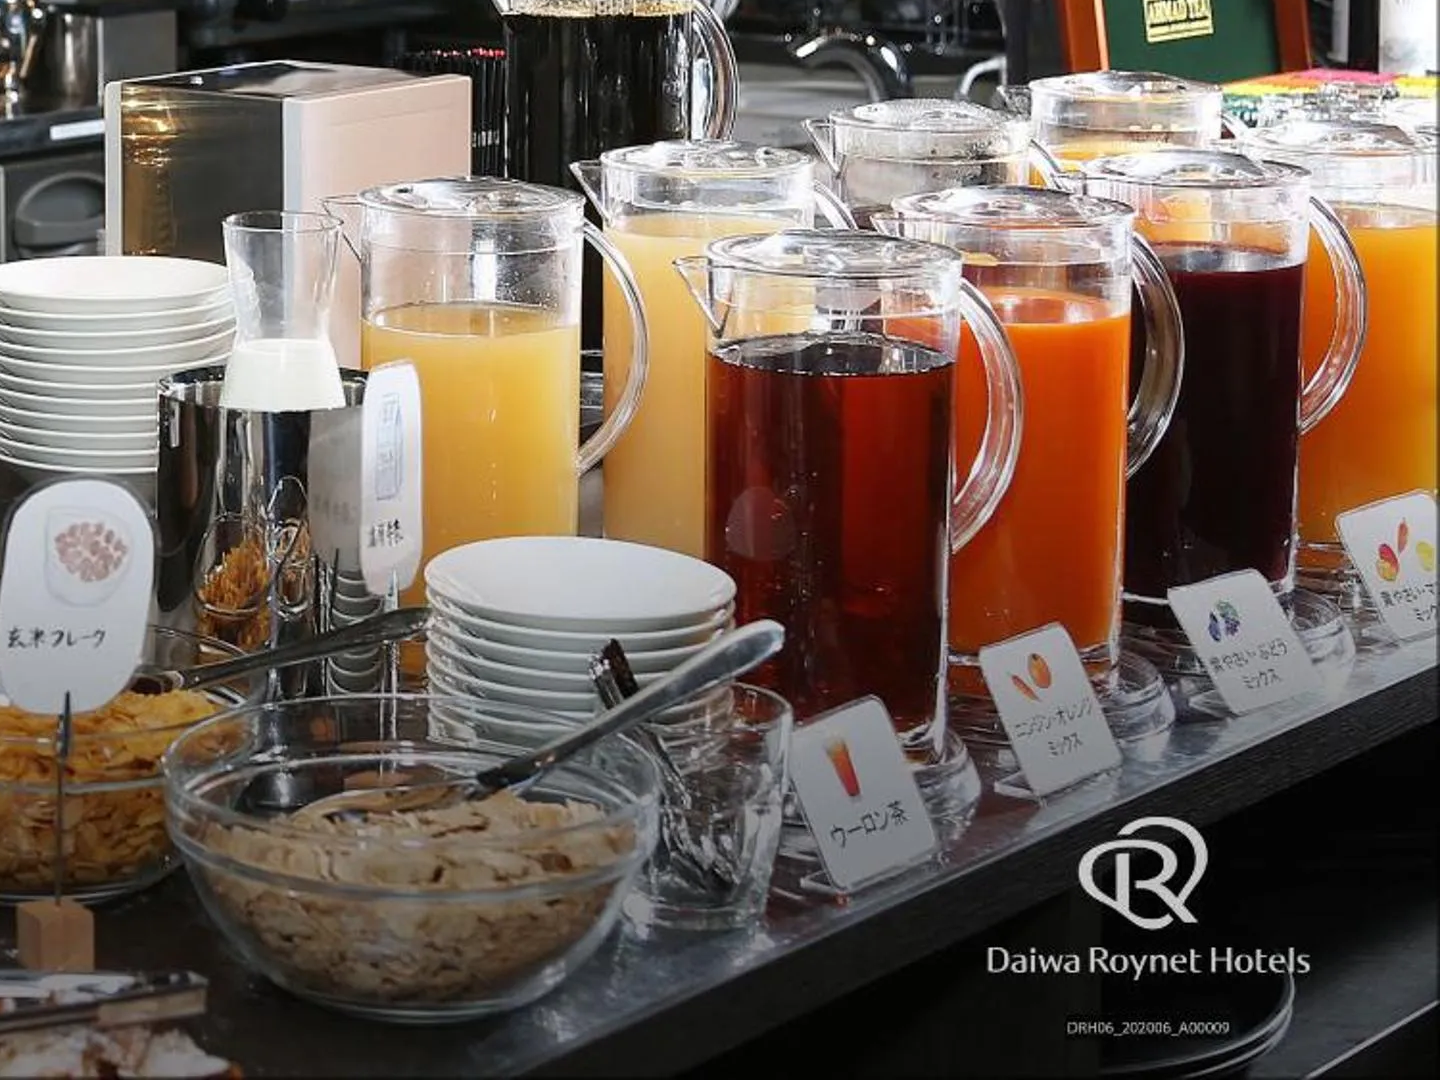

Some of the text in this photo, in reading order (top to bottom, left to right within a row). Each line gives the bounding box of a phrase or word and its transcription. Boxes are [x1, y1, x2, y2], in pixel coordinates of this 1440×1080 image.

[7, 626, 106, 649] 玄米フレーク
[830, 800, 909, 848] ウーロン茶
